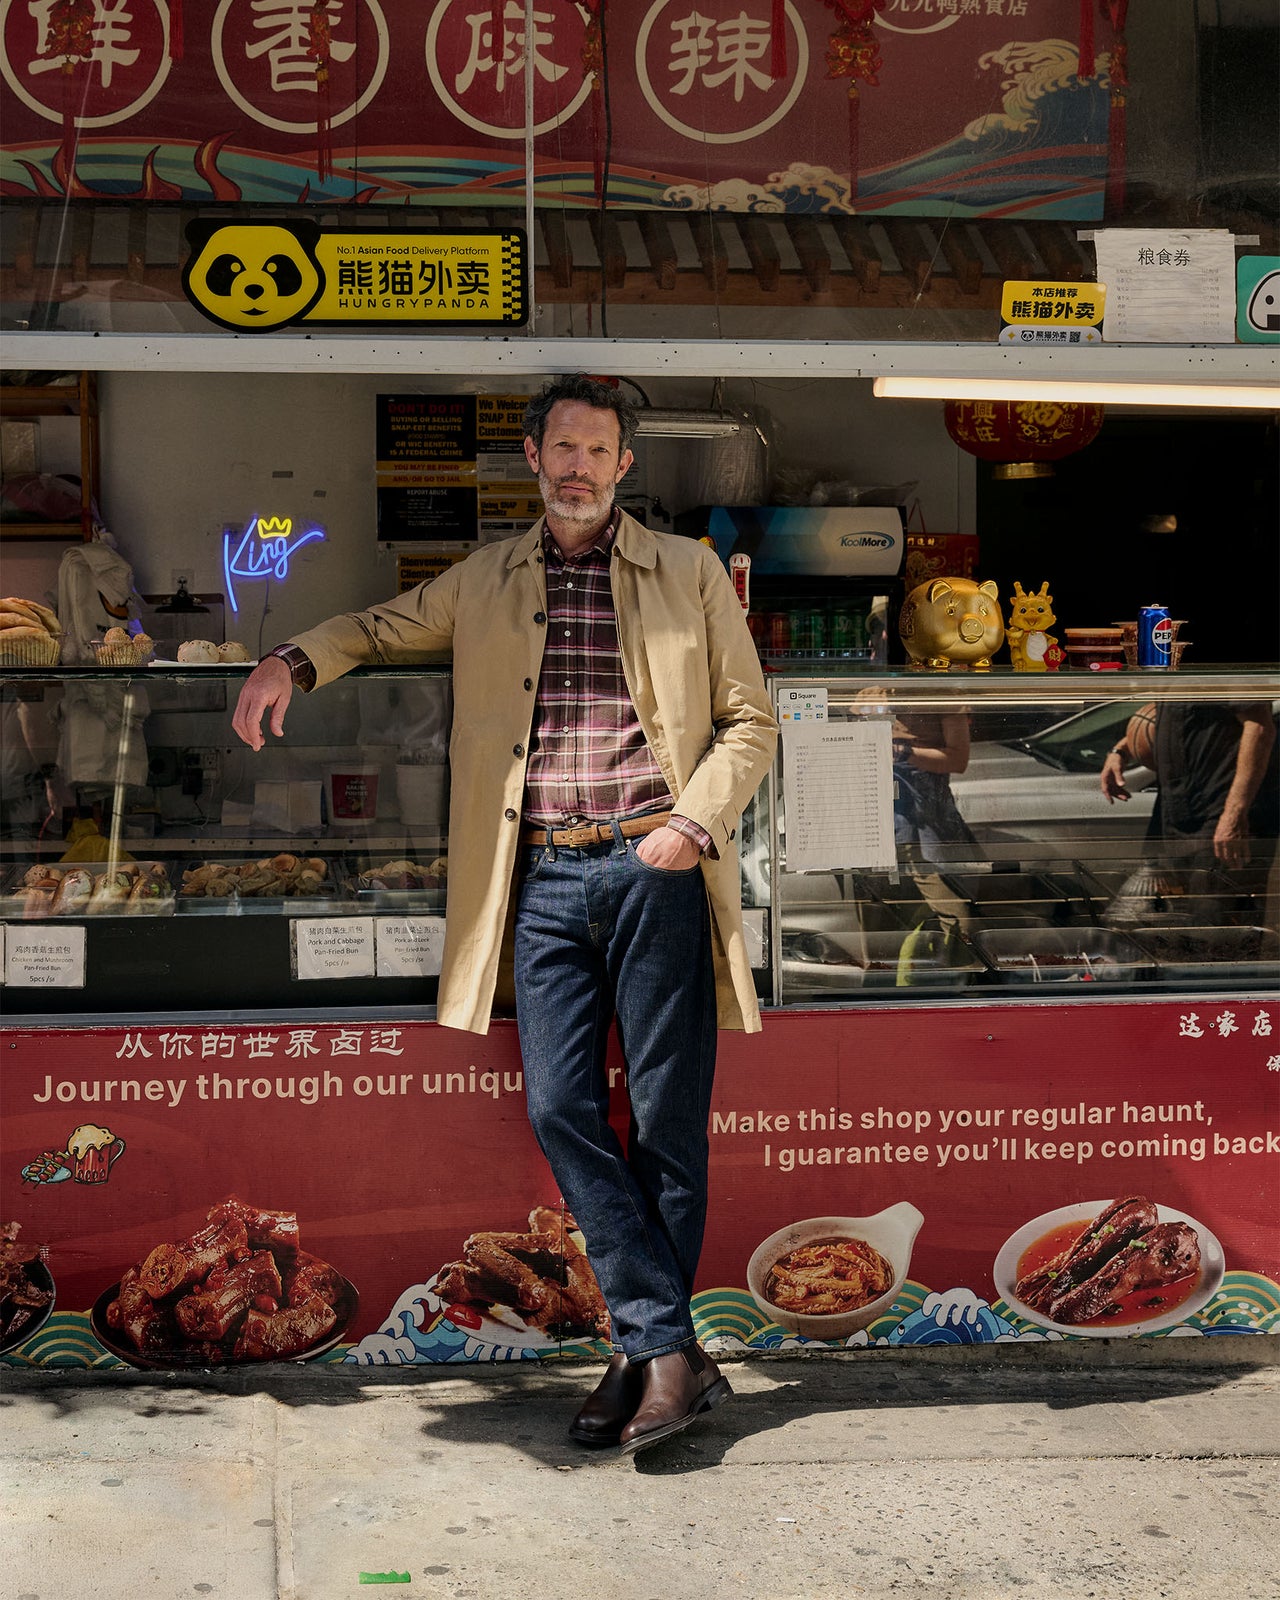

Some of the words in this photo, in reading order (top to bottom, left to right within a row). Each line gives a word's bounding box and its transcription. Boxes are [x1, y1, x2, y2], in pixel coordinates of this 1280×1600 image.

[455, 0, 569, 94] 麻
[668, 10, 776, 102] 辣
[337, 246, 356, 255] No.1
[358, 246, 384, 255] Asian
[386, 246, 409, 255] Food
[412, 246, 449, 257] Delivery
[451, 246, 490, 255] Platform
[1138, 247, 1190, 266] 粮食券
[338, 260, 490, 296] 熊猫外卖
[1032, 287, 1078, 298] 本店推荐
[339, 298, 490, 309] HUNGRYPANDA
[1011, 300, 1095, 319] 熊猫外卖
[429, 403, 447, 414] DO
[479, 400, 493, 409] We
[496, 400, 528, 409] Welco
[432, 416, 463, 424] SELLING
[479, 413, 503, 423] SNAP
[507, 413, 523, 423] EBT
[428, 424, 462, 432] BENEFITS
[840, 537, 888, 547] KoolMore
[223, 517, 325, 613] King
[400, 569, 435, 579] Clientes
[346, 947, 359, 955] Bun
[30, 975, 45, 983] 5pcs
[115, 1028, 405, 1060] 从你的世界卤过
[33, 1075, 187, 1107] Journey
[196, 1070, 343, 1104] through
[353, 1073, 413, 1096] our
[712, 1110, 790, 1134] Make
[797, 1107, 853, 1131] this
[860, 1106, 931, 1134] shop
[938, 1108, 1005, 1133] your
[1011, 1102, 1116, 1131] regular
[1123, 1100, 1213, 1126] haunt,
[764, 1144, 771, 1167] I
[778, 1142, 929, 1172] guarantee
[1024, 1138, 1094, 1164] keep
[1100, 1133, 1206, 1161] coming
[1213, 1131, 1280, 1155] back
